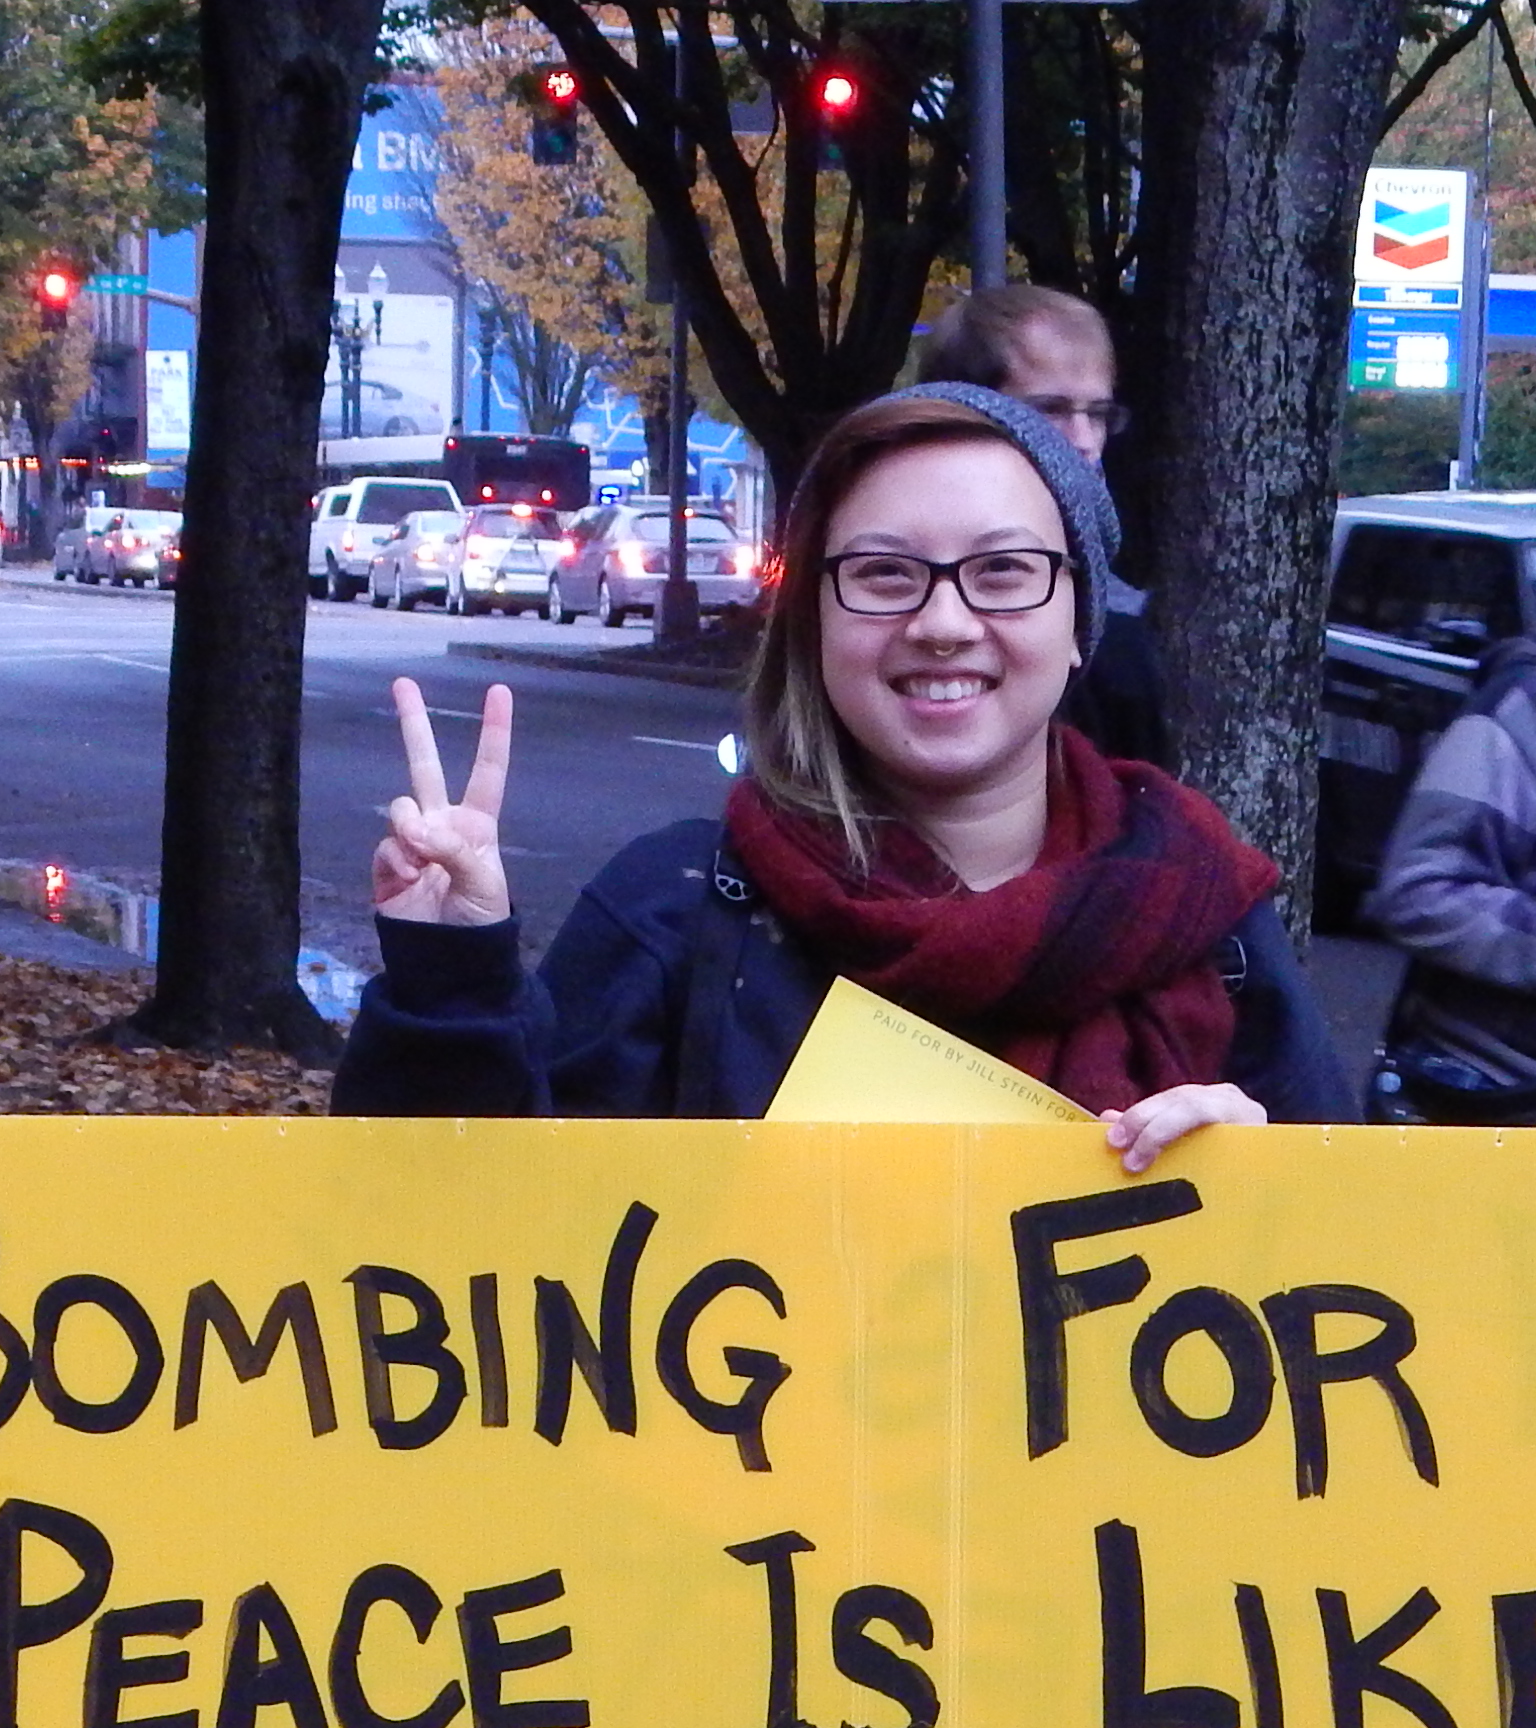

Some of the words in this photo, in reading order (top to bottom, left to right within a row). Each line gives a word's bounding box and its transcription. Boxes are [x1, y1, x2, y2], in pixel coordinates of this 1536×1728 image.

[345, 190, 376, 215] ing
[1374, 178, 1453, 196] Chevron
[873, 1009, 907, 1036] PAID
[910, 1029, 942, 1053] FOR
[944, 1047, 965, 1065] BY
[966, 1059, 995, 1083] JILL
[1000, 1076, 1043, 1107] STEIN
[1046, 1101, 1077, 1122] FOR
[1010, 1179, 1439, 1499] FOR
